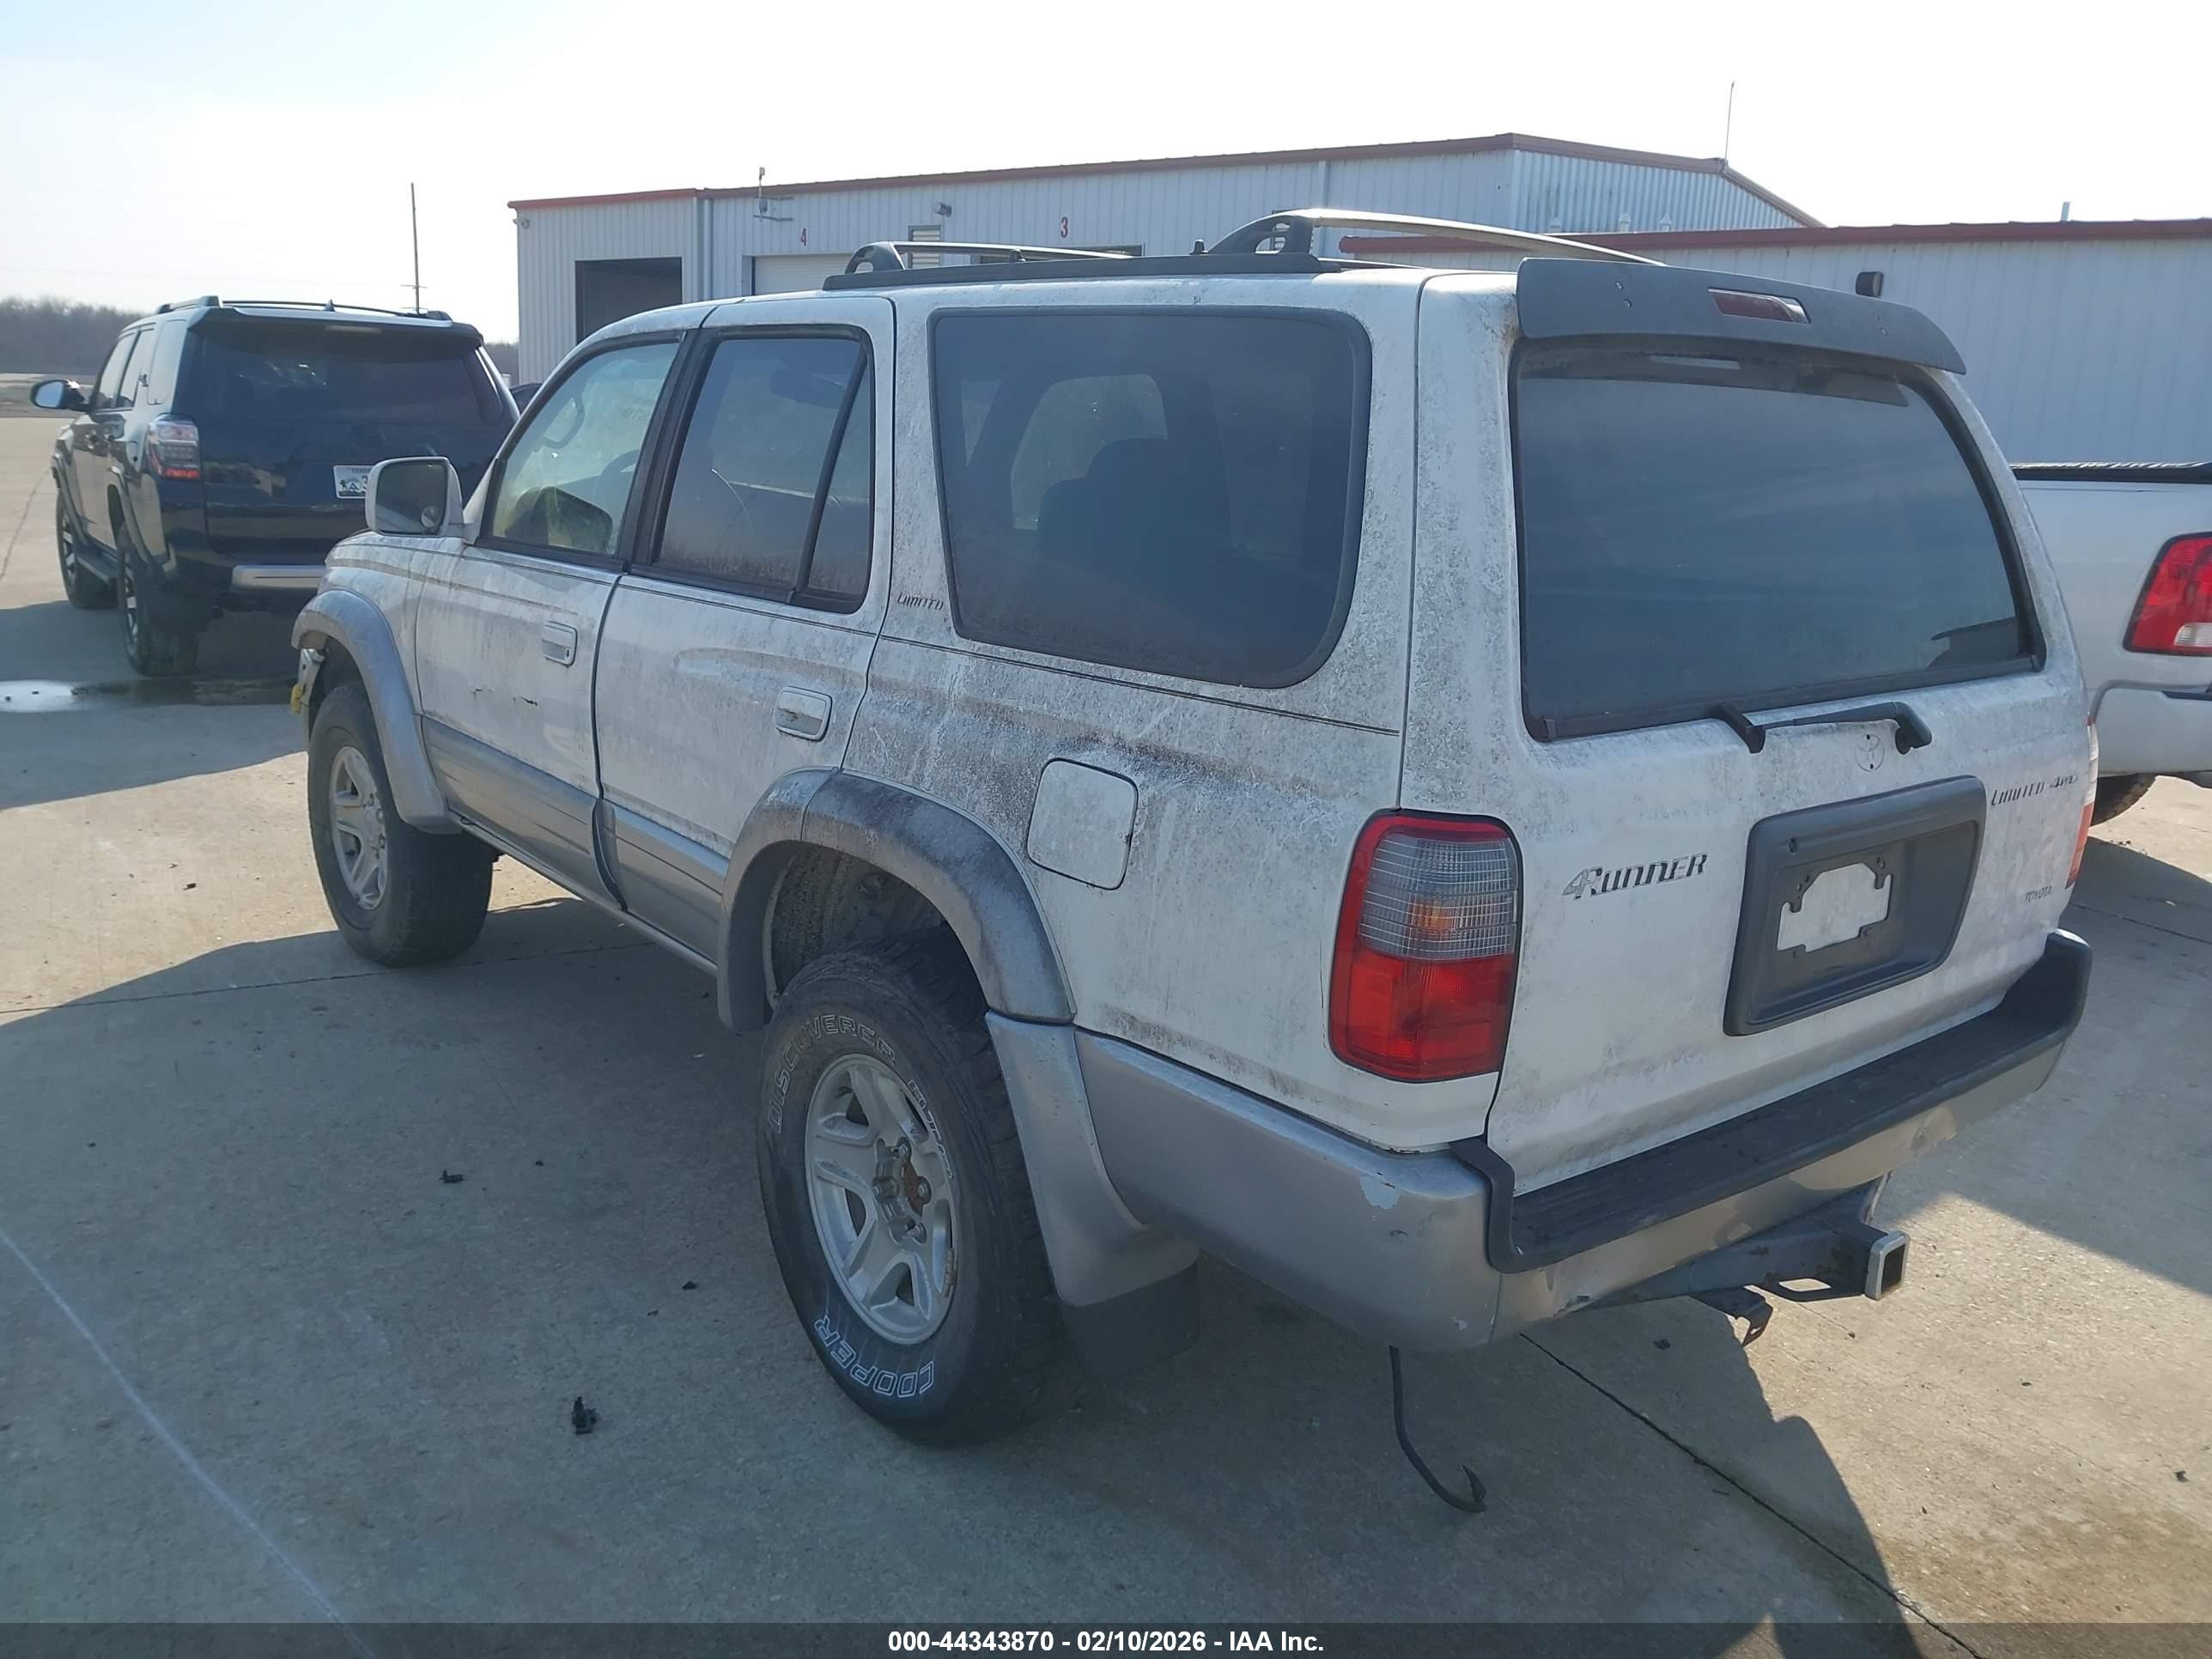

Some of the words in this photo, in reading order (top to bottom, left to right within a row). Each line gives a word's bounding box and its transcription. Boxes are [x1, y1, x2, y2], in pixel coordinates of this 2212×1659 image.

[800, 228, 807, 246] 4
[1060, 216, 1068, 239] 3
[2025, 885, 2052, 902] TOYOTA
[768, 1013, 896, 1134] DISCOVERER
[814, 1314, 934, 1398] COOPER
